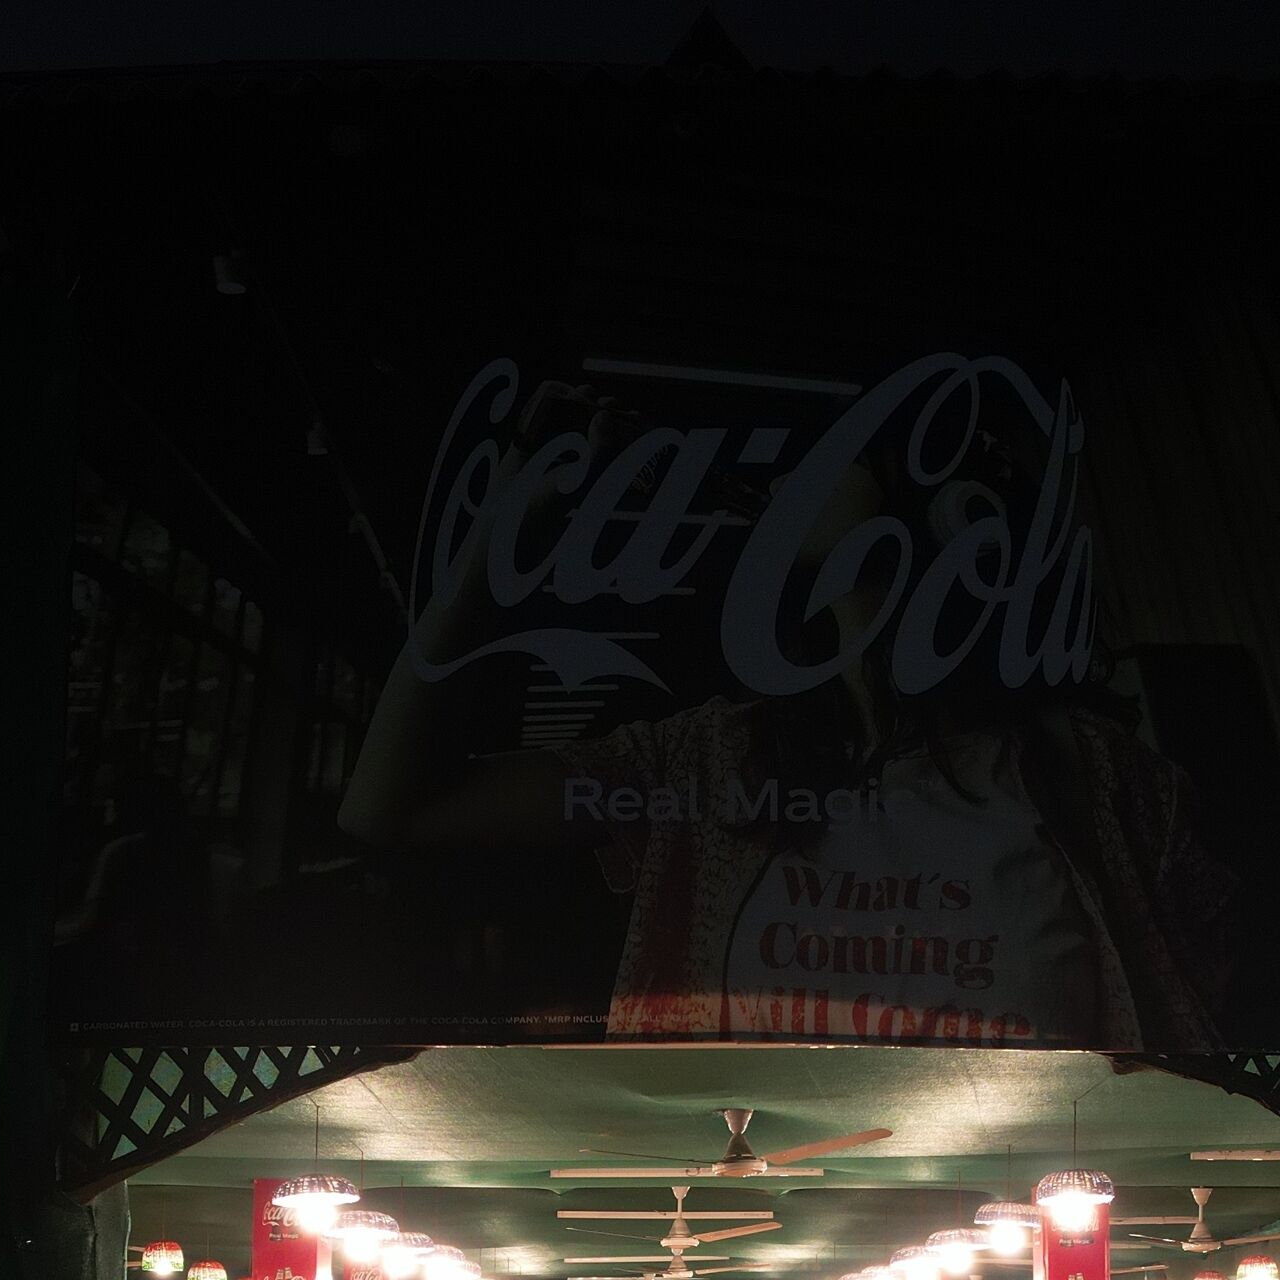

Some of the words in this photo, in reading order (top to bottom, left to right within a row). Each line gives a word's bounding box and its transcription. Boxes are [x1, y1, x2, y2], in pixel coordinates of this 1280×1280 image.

[408, 351, 1098, 696] Coca-Cola
[562, 776, 701, 823] Real
[781, 864, 972, 912] What's
[759, 921, 1000, 990] Coming
[82, 1021, 148, 1031] CARBONATED
[267, 1018, 327, 1027] REGISTERED
[330, 1017, 391, 1026] TRADEMARK
[490, 1016, 542, 1025] COMPANY.
[573, 1014, 625, 1024] INCLUS
